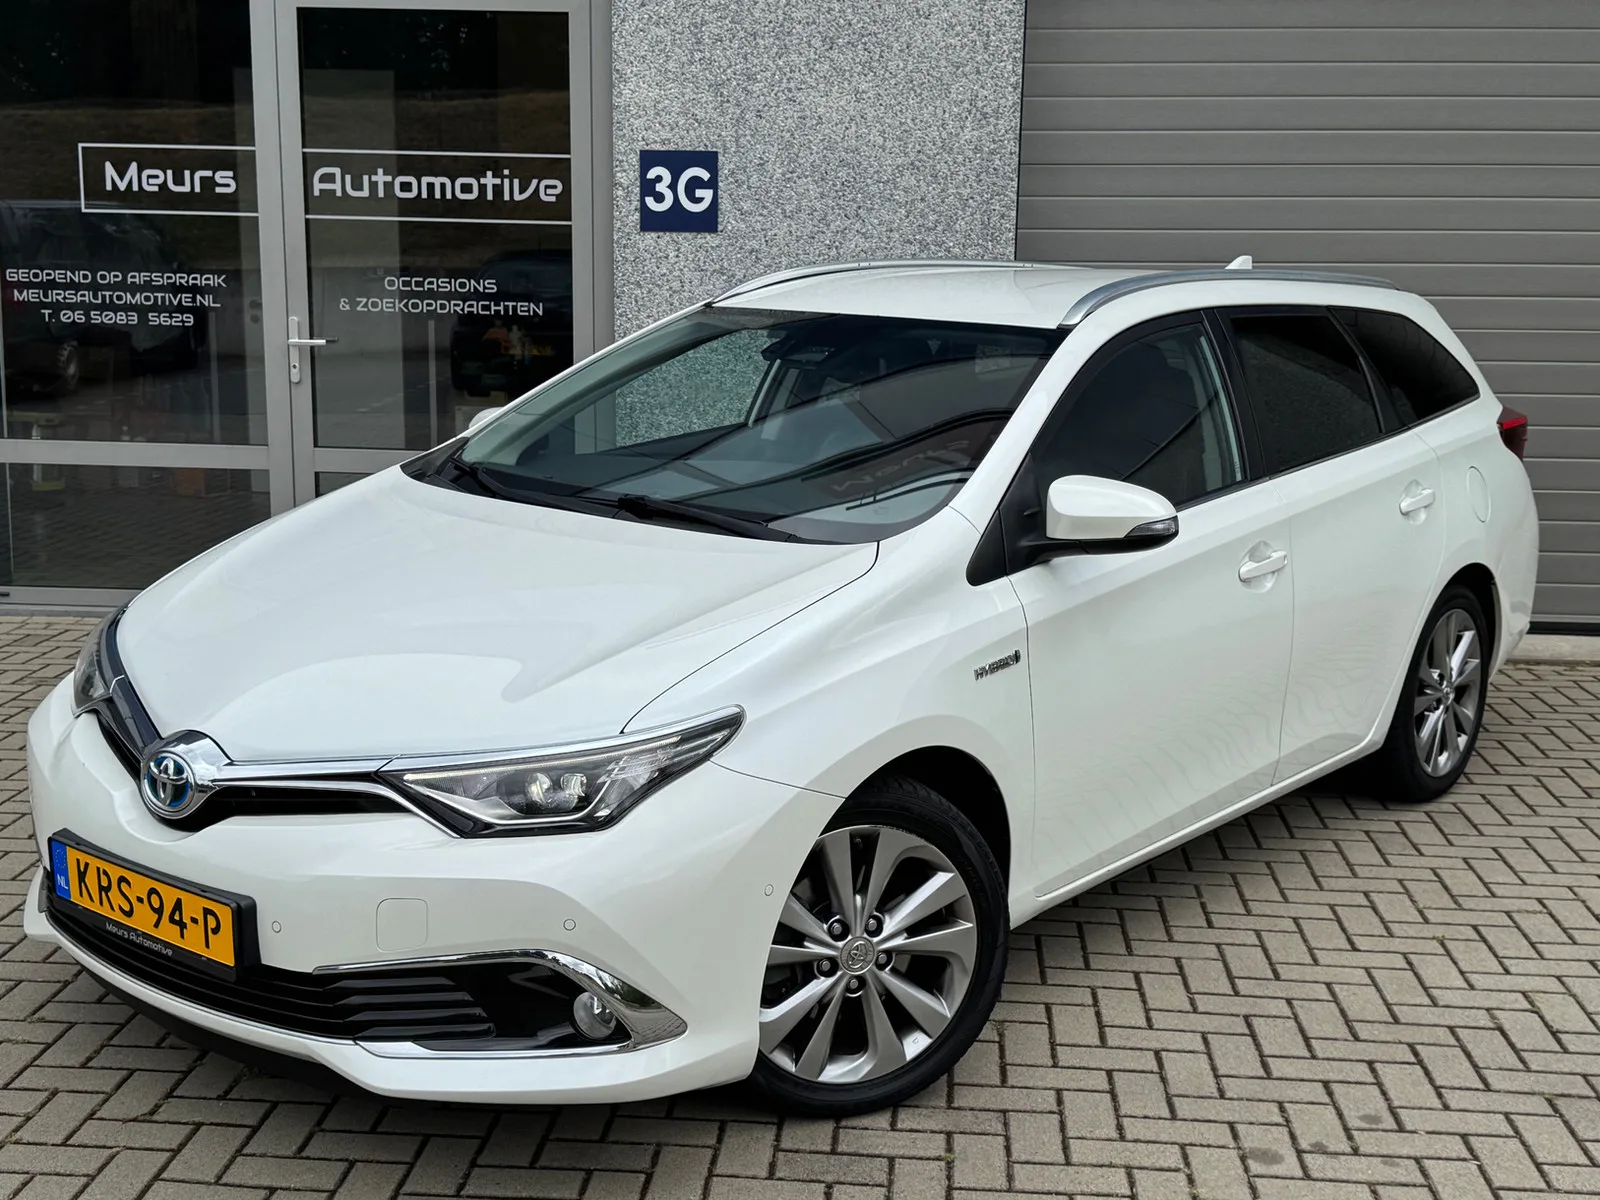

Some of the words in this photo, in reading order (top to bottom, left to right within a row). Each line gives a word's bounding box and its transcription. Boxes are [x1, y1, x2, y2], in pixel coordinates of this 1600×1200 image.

[104, 161, 237, 194] Meurs
[312, 166, 563, 202] Automotive
[644, 166, 714, 213] 3G
[6, 268, 92, 284] GEOPEND
[97, 271, 122, 284] OP
[127, 272, 227, 287] AFSPRAAK
[384, 276, 498, 293] OCCASIONS
[13, 289, 221, 307] MEURSAUTOMOTIVE.NL
[339, 298, 351, 311] &
[356, 298, 543, 316] ZOEKOPDRACHTEN
[41, 309, 56, 322] T.
[60, 311, 85, 323] 06
[90, 312, 138, 325] 5083
[148, 313, 194, 326] 5629
[57, 873, 69, 889] NL
[75, 857, 222, 949] KRS-94-P
[105, 921, 129, 939] Meurs
[129, 932, 173, 956] Automotive
